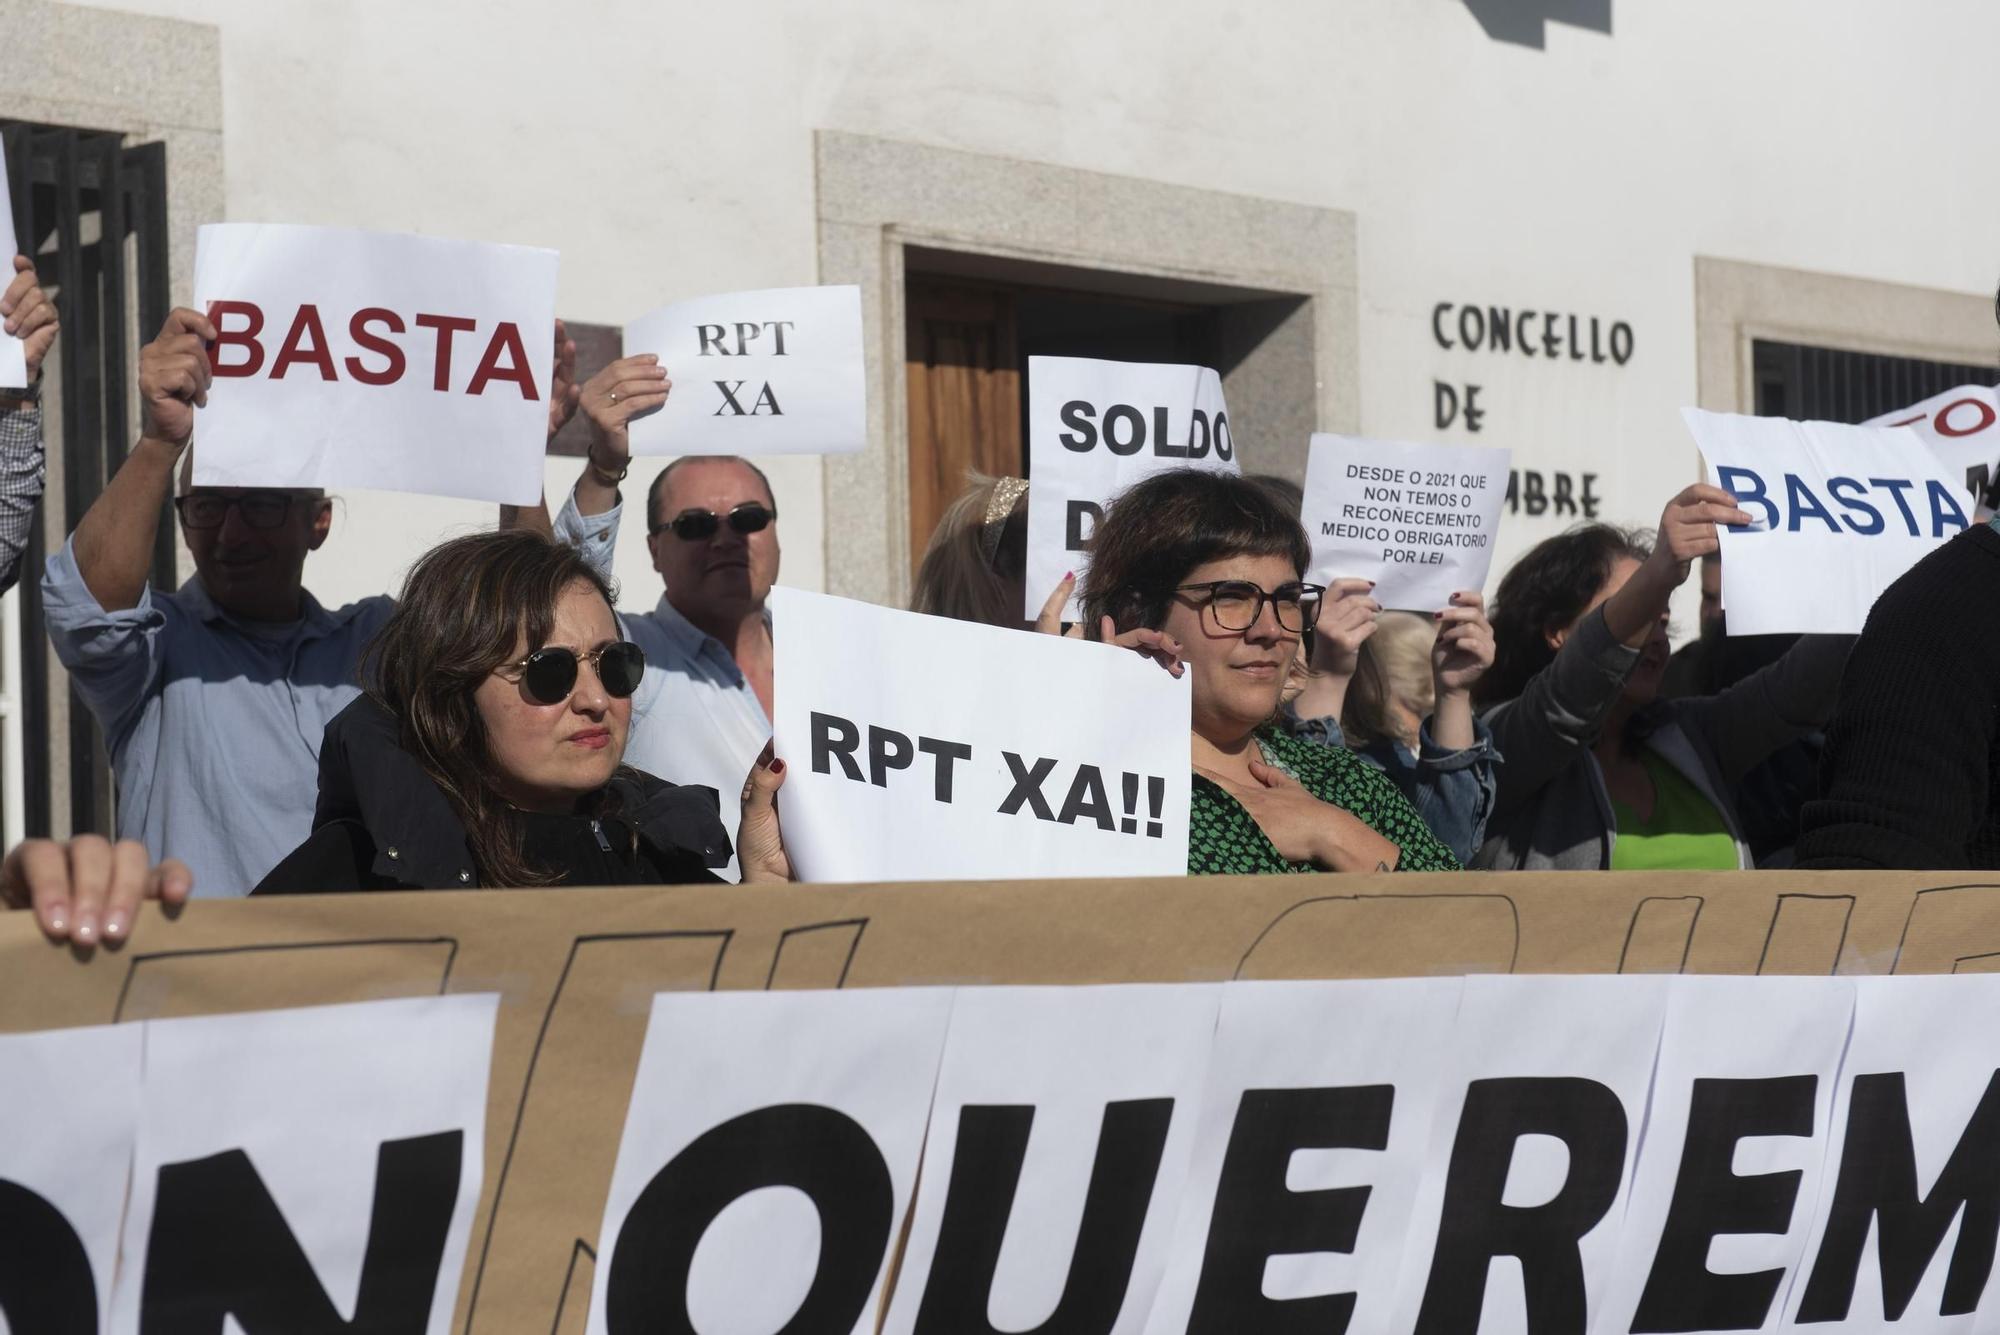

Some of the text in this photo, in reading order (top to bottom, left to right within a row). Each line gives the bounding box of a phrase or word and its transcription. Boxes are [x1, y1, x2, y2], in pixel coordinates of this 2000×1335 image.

[206, 300, 540, 401] BASTA
[695, 321, 795, 357] RPT
[1432, 302, 1634, 367] CONCELLO
[712, 380, 784, 417] XA
[1432, 379, 1485, 433] DE
[1886, 398, 1996, 437] O
[1059, 400, 1233, 462] SOLDO
[1346, 464, 1487, 489] DESDE O 2021 QUE
[1342, 504, 1481, 528] RECOÑECEMENTO
[1364, 487, 1472, 508] NON TEMOS O
[1716, 465, 1970, 538] BASTA
[1321, 522, 1487, 548] MEDICO OBRIGATORIO
[1383, 548, 1444, 565] POR LEI
[810, 711, 1165, 838] RPT XA!!
